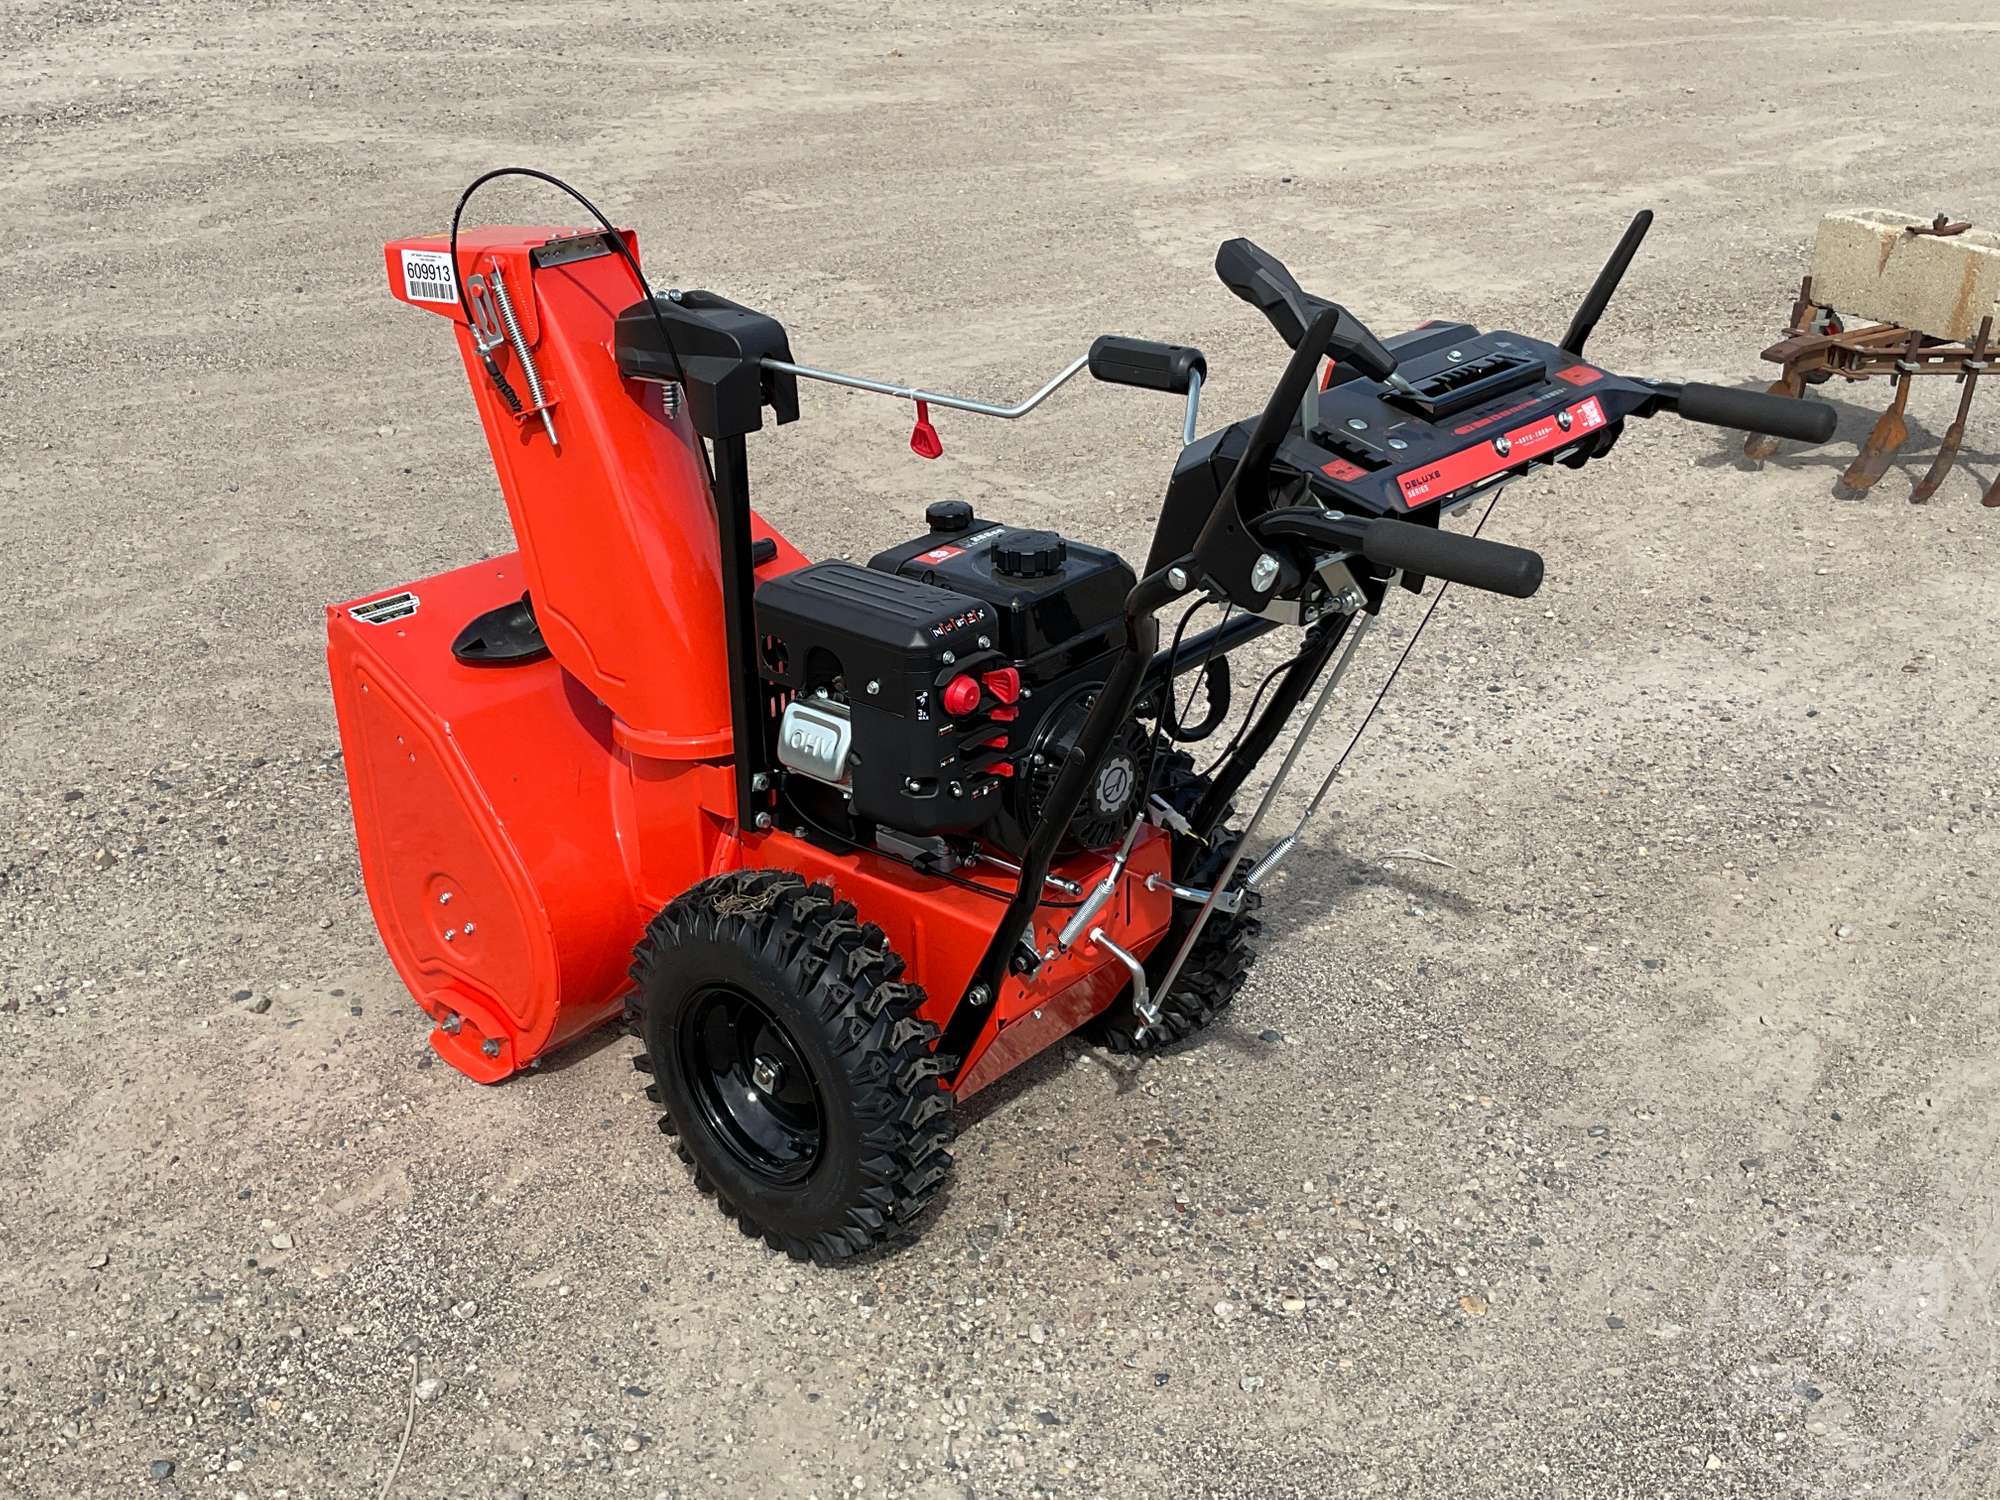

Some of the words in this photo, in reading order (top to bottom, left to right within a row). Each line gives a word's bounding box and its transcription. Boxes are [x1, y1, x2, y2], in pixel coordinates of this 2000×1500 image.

[407, 262, 451, 282] 609913
[1404, 470, 1441, 489] DELUXE
[1407, 484, 1430, 499] SERIES
[790, 728, 833, 760] OHV
